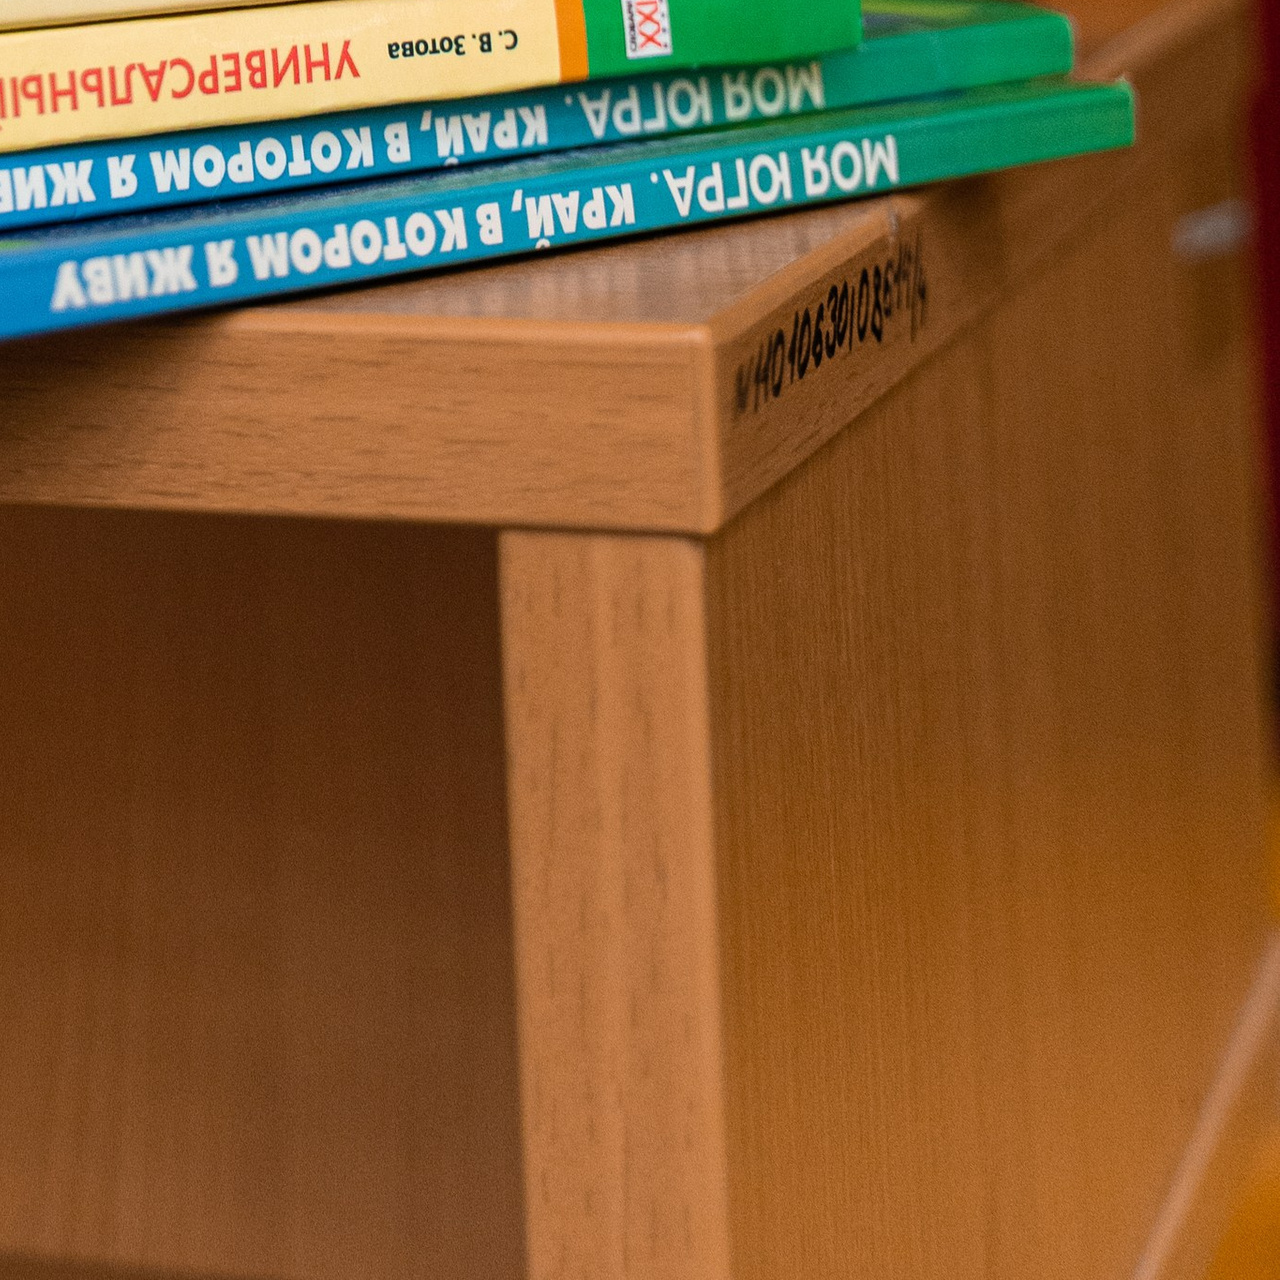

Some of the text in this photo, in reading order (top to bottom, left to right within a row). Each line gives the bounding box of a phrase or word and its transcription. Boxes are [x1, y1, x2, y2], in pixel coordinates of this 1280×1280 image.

[388, 28, 518, 62] С. В. Зотова
[565, 78, 710, 137] ЮГРА.
[721, 61, 824, 121] МОЯ
[149, 128, 375, 194] КОТОРОМ
[385, 121, 411, 162] В
[420, 105, 548, 165] КРАЙ,
[107, 154, 137, 191] Я
[51, 135, 898, 311] МОЯ ЮГРА. КРАЙ, В КОТОРОМ Я ЖИВУ
